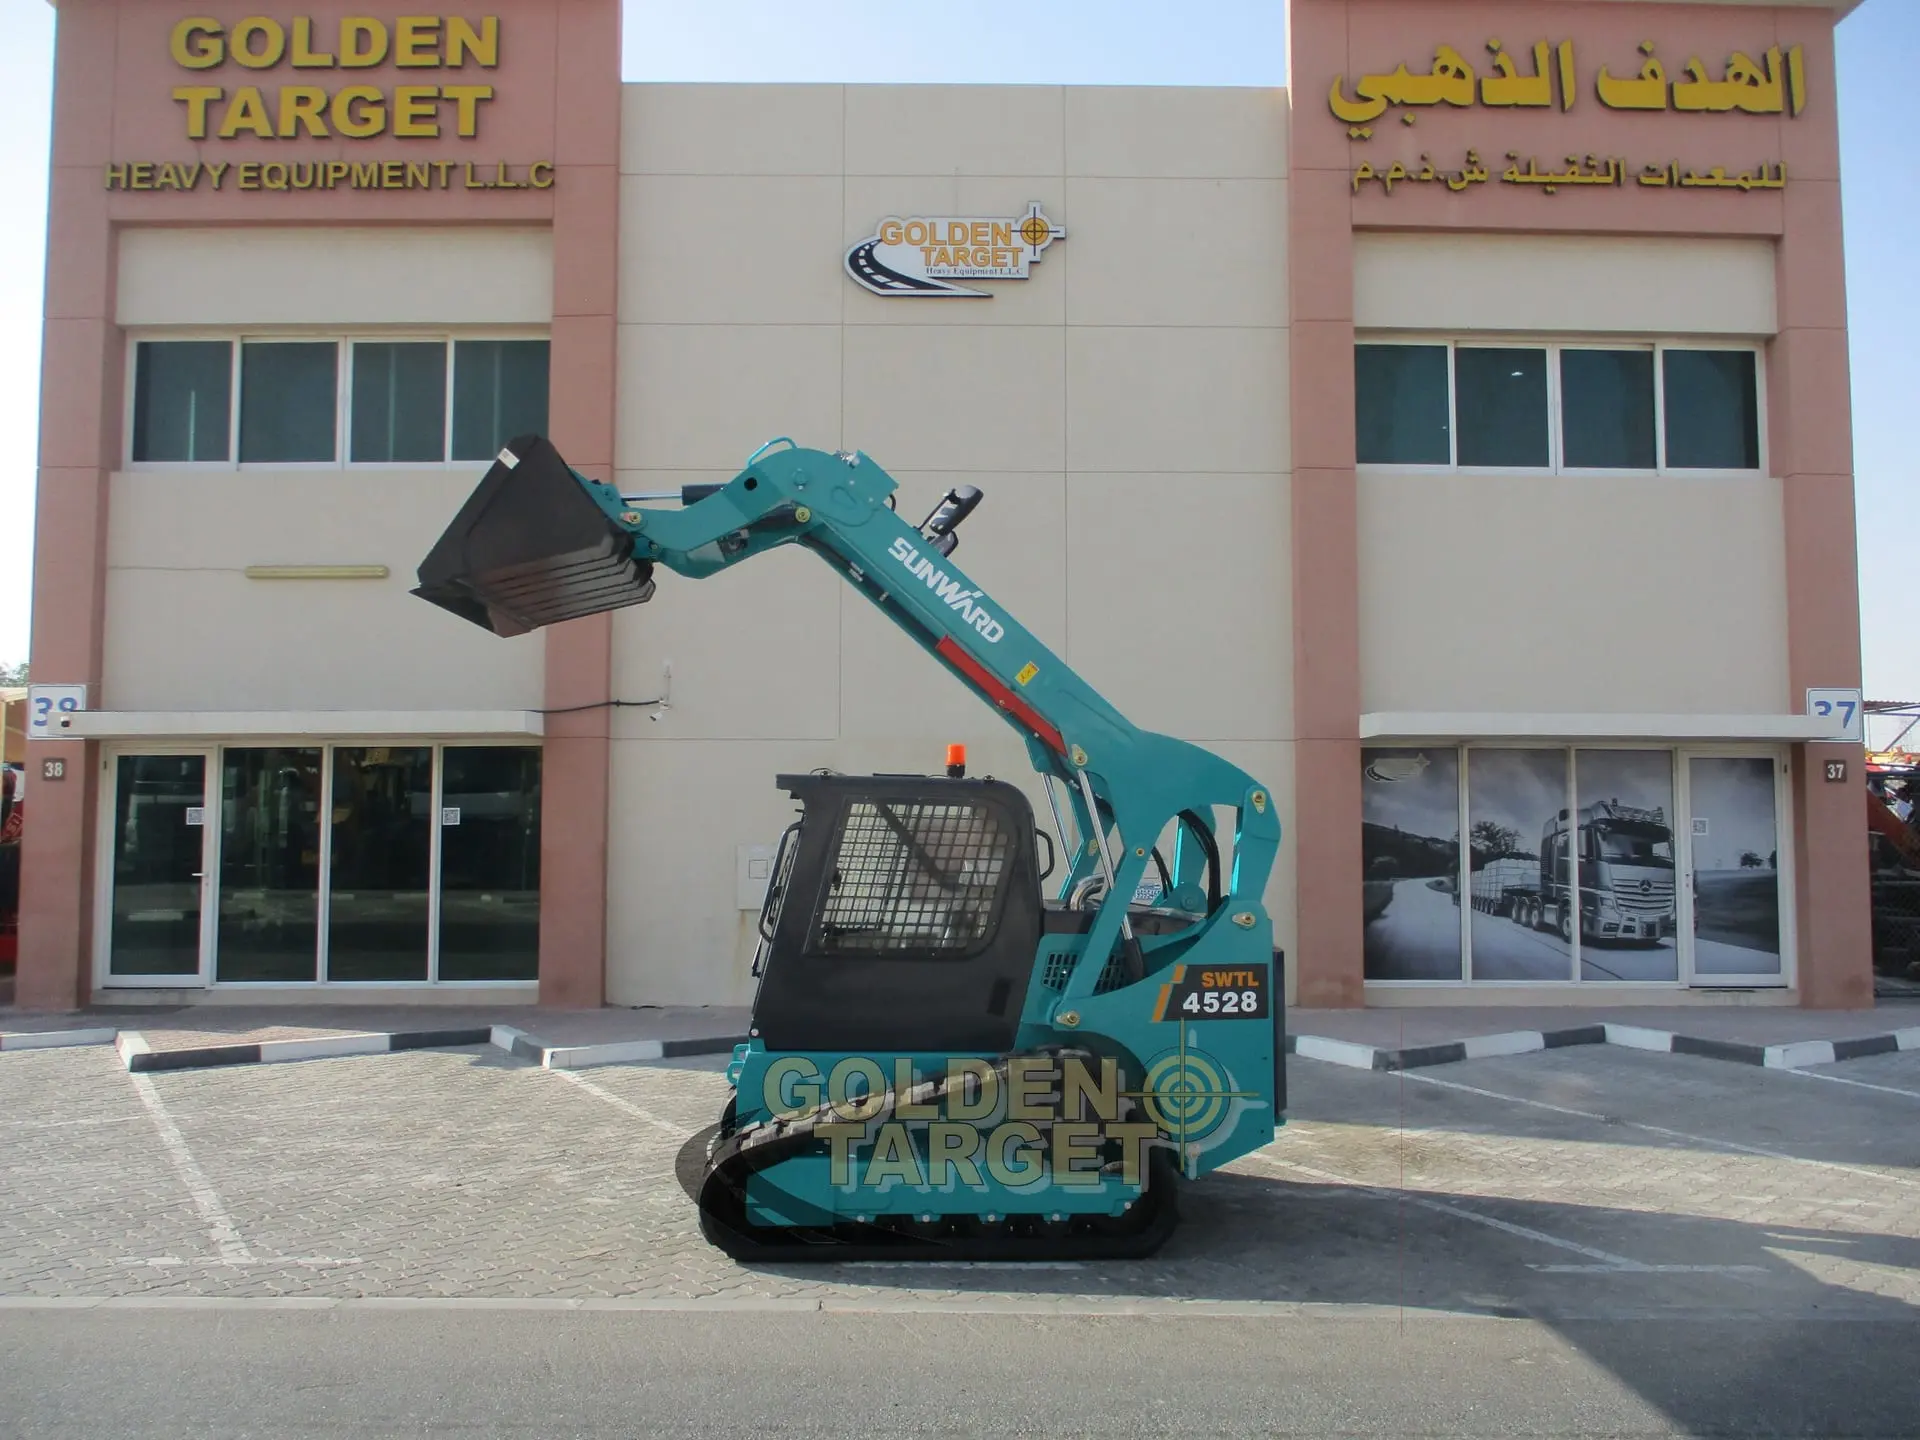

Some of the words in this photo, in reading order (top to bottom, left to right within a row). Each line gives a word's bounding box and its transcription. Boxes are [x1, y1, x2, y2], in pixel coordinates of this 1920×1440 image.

[170, 16, 500, 70] GOLDEN
[1329, 39, 1576, 139] الذهبي
[1597, 40, 1805, 116] الهدف
[172, 85, 494, 138] TARGET
[105, 161, 230, 190] HEAVY
[237, 160, 456, 190] EQUIPMENT
[464, 160, 555, 188] L.L.C
[1502, 151, 1627, 193] الثقيلة
[1638, 159, 1788, 190] للمعدات
[880, 221, 1012, 246] GOLDEN
[920, 247, 1024, 267] TARGET
[888, 537, 1005, 643] SUNWARD
[44, 761, 64, 778] 38
[1827, 763, 1845, 780] 37
[1201, 970, 1260, 989] SWTL
[1182, 991, 1259, 1014] 4528
